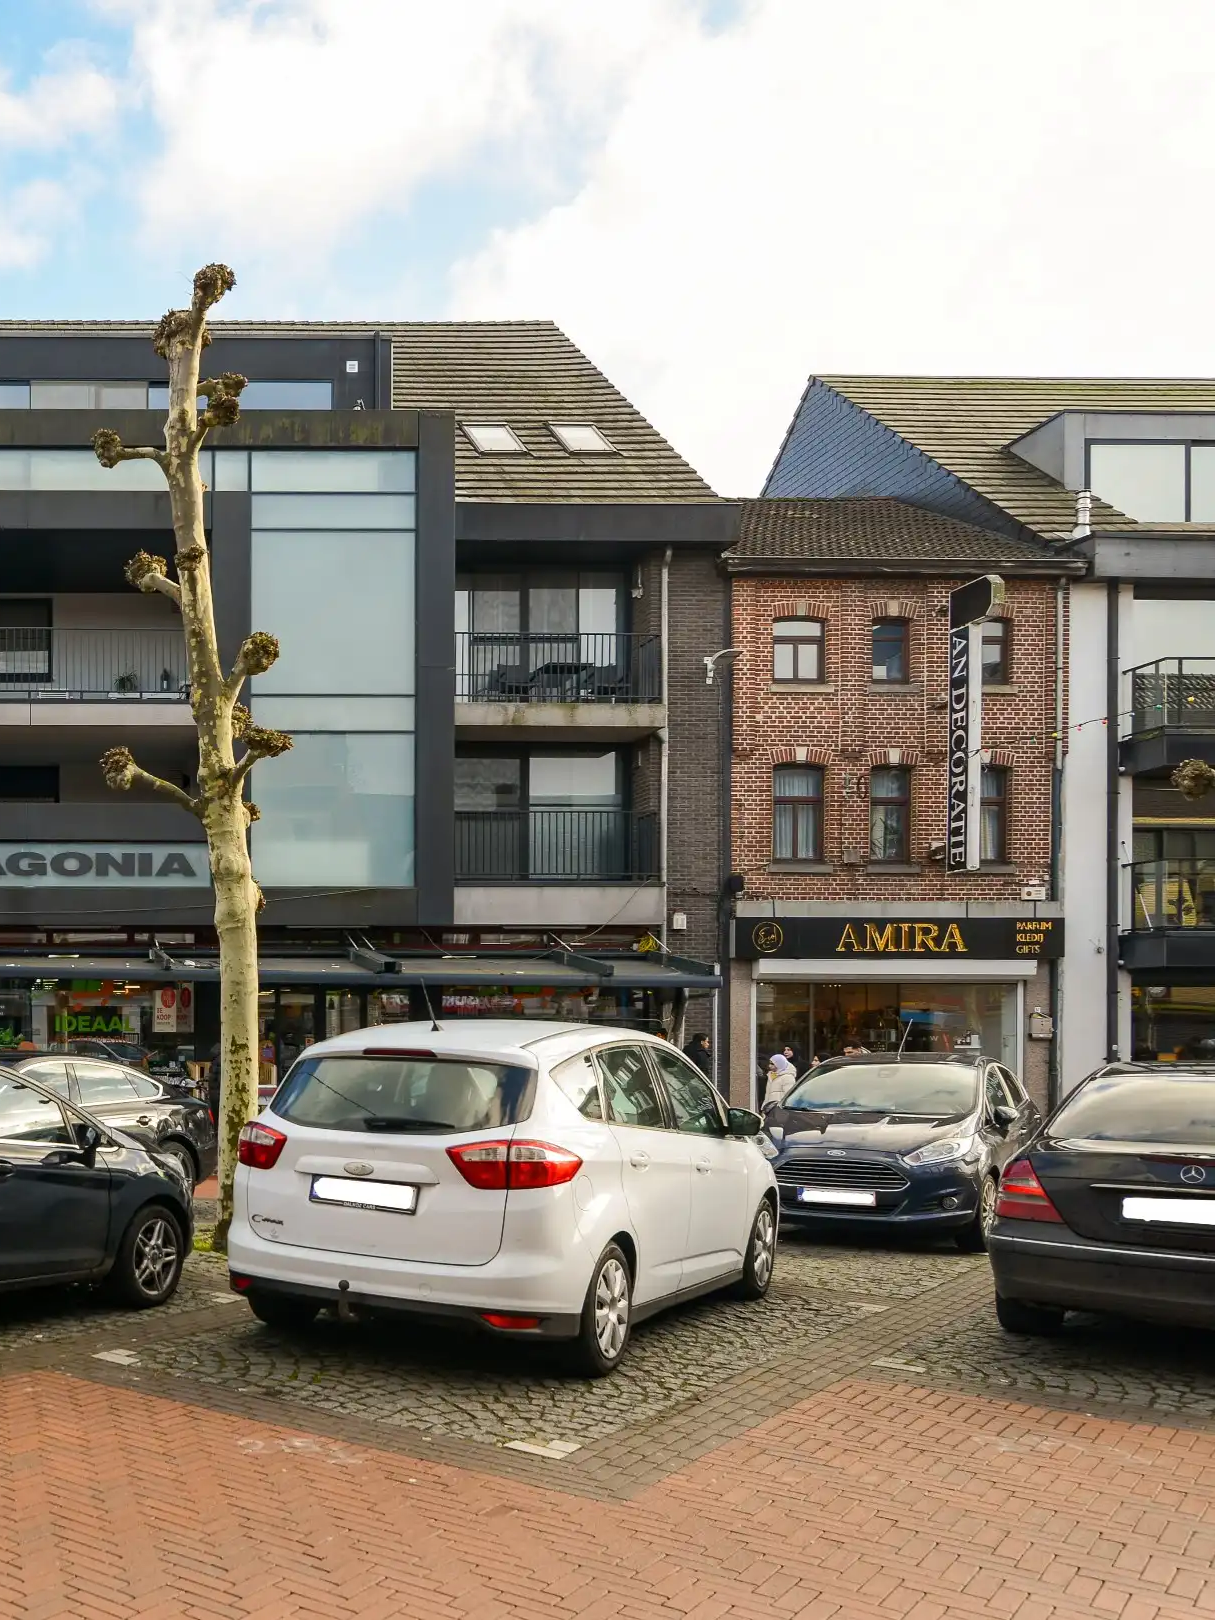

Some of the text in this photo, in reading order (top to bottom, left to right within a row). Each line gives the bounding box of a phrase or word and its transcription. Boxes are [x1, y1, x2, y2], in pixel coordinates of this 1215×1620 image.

[950, 683, 967, 866] DECORATIE
[1016, 921, 1052, 930] PARFUM
[836, 922, 969, 952] AMIRA
[1016, 945, 1041, 954] GIFTS
[54, 1015, 135, 1032] IDEAAL
